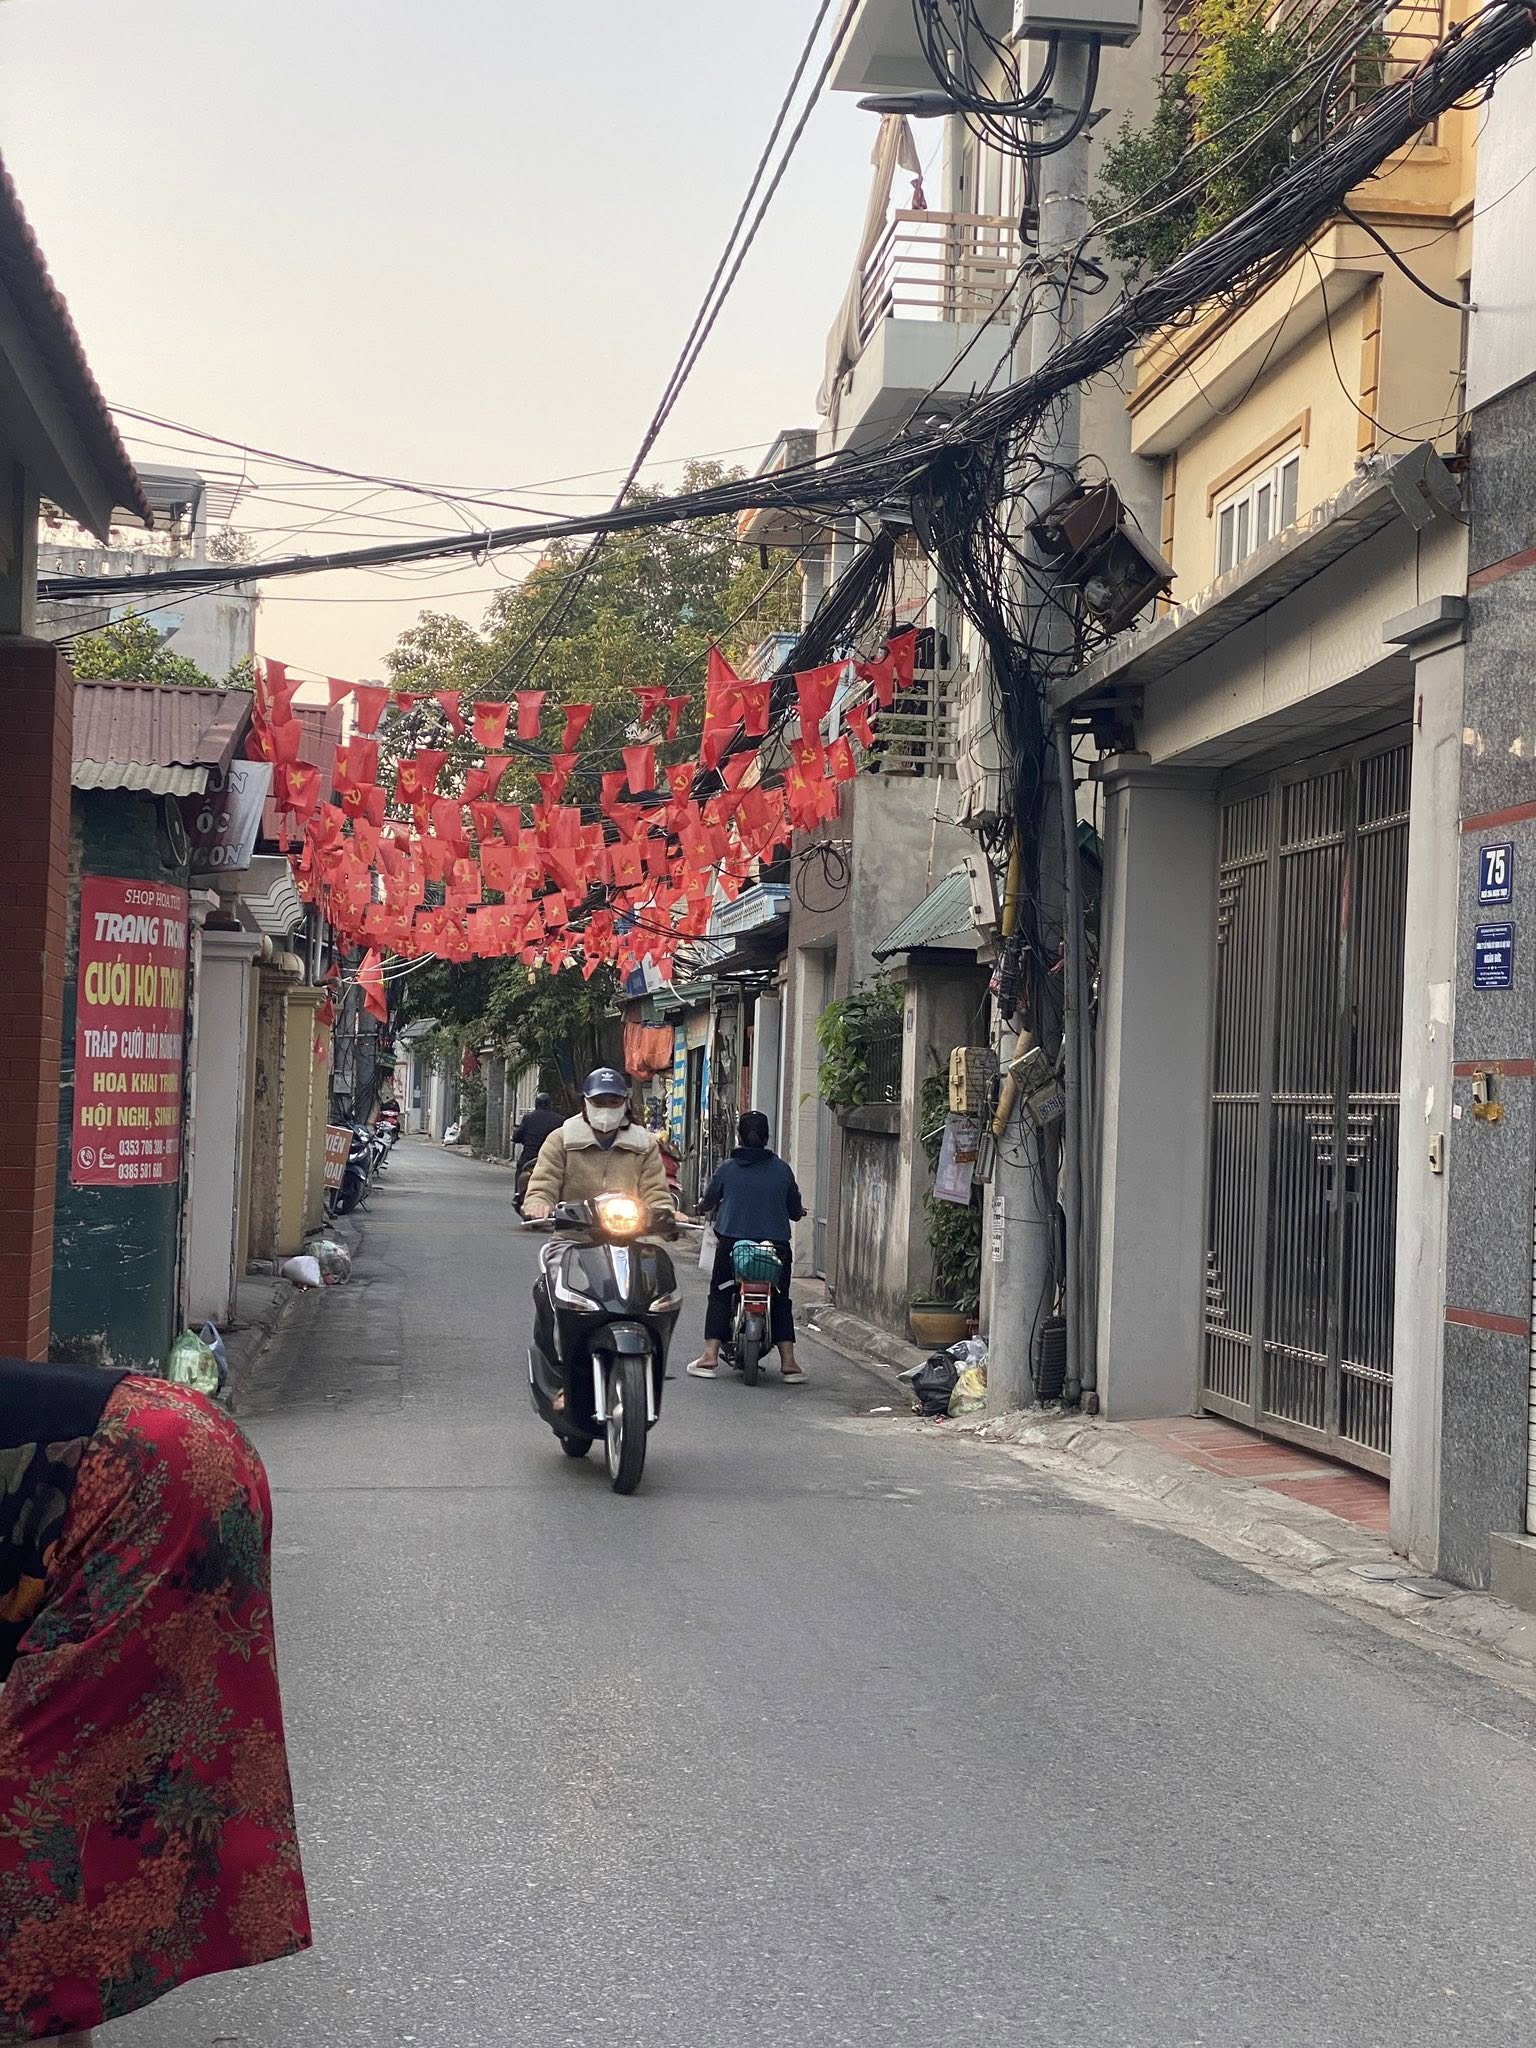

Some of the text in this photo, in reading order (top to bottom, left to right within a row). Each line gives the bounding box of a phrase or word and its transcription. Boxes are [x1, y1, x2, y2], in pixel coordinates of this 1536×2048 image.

[196, 798, 231, 834] ỐC
[189, 843, 243, 867] GON
[1486, 849, 1505, 886] 75
[124, 889, 155, 906] SHOP
[155, 891, 170, 909] HOA
[94, 911, 160, 946] TRANG
[84, 953, 131, 1006] CƯỚI
[134, 951, 158, 1008] HỎI
[84, 1024, 117, 1058] TRÁP
[121, 1026, 144, 1059] CƯỚI
[145, 1023, 157, 1059] HỎI
[93, 1072, 127, 1093] HOA
[131, 1073, 158, 1093] KHAI
[81, 1102, 113, 1131] HỘI
[117, 1107, 152, 1131] NGHỊ,
[118, 1139, 140, 1156] 0353
[118, 1163, 139, 1180] 0385
